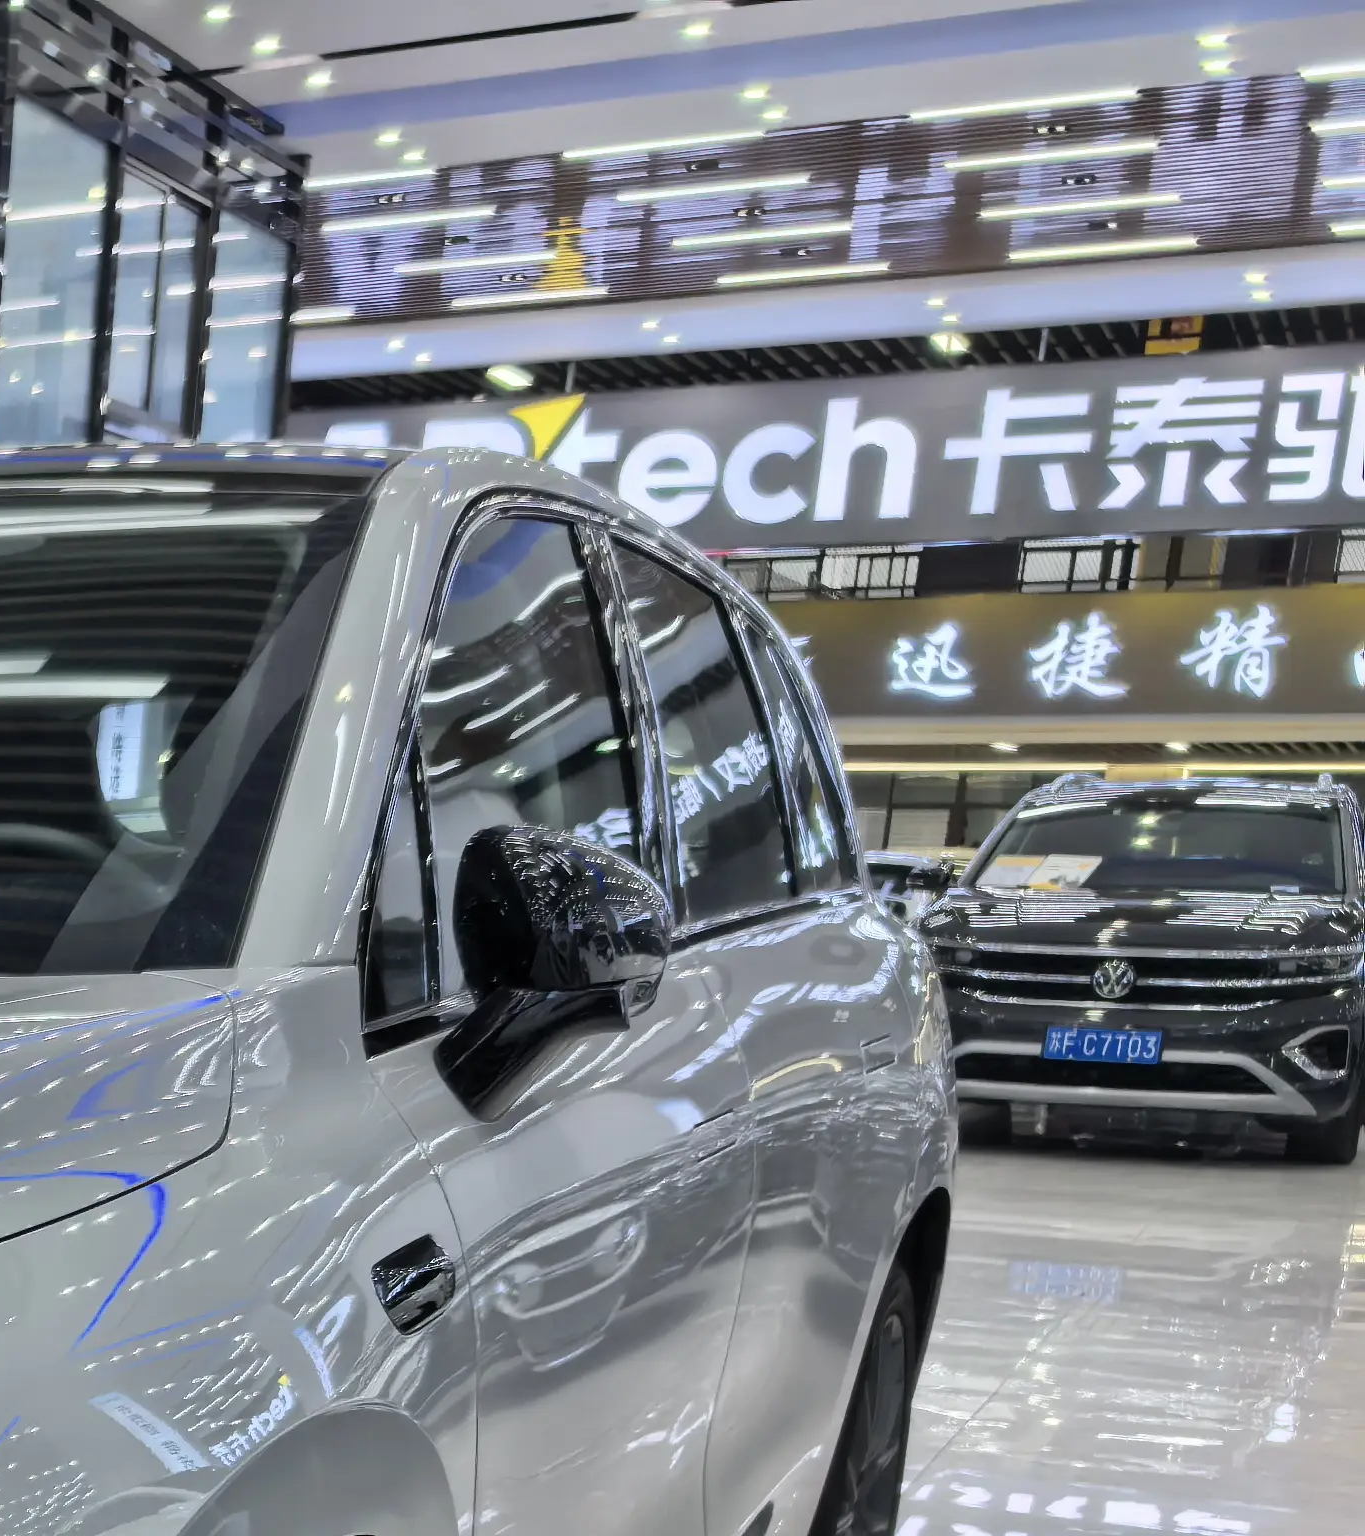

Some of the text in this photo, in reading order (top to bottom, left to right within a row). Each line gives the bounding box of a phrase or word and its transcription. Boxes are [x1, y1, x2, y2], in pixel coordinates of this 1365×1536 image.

[323, 393, 917, 527] tech
[793, 603, 1365, 701] 迅捷精
